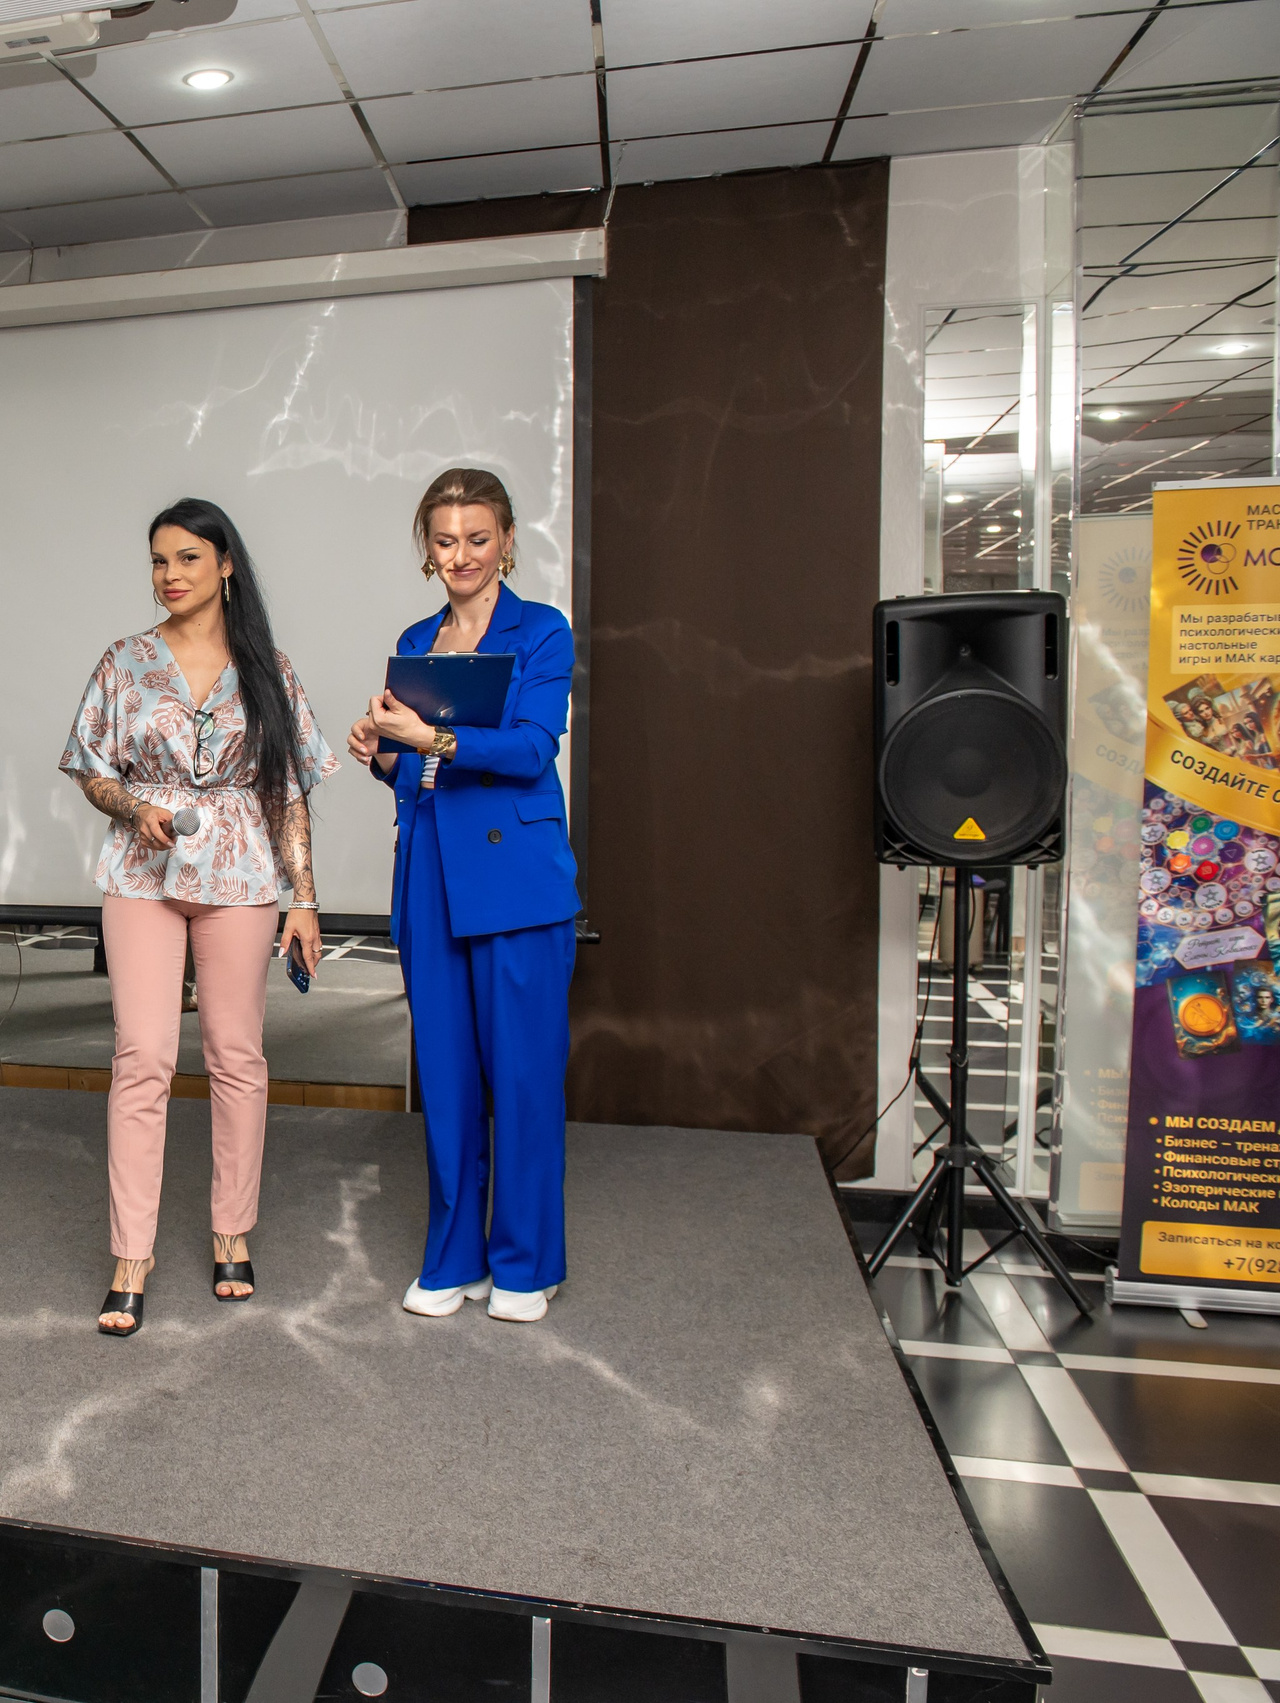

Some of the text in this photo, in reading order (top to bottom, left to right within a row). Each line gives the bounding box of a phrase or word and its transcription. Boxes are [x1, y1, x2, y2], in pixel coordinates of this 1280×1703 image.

[1247, 504, 1280, 515] МАС
[1180, 612, 1280, 625] Мы разрабаты
[1179, 628, 1280, 637] психологическ
[1179, 641, 1258, 650] настольные
[1179, 656, 1211, 665] игры
[1226, 653, 1256, 663] МАК
[1170, 749, 1270, 798] СОЗДАЙТЕ
[1165, 1115, 1194, 1128] МЫ
[1196, 1117, 1276, 1134] СОЗДАЕМ
[1164, 1135, 1218, 1149] Бизнес
[1235, 1141, 1280, 1154] трена
[1163, 1150, 1280, 1169] Финансовые ст
[1161, 1181, 1277, 1199] Эзотерические
[1160, 1196, 1260, 1214] Колоды МАК
[1158, 1231, 1241, 1247] Записаться
[1245, 1240, 1263, 1249] на
